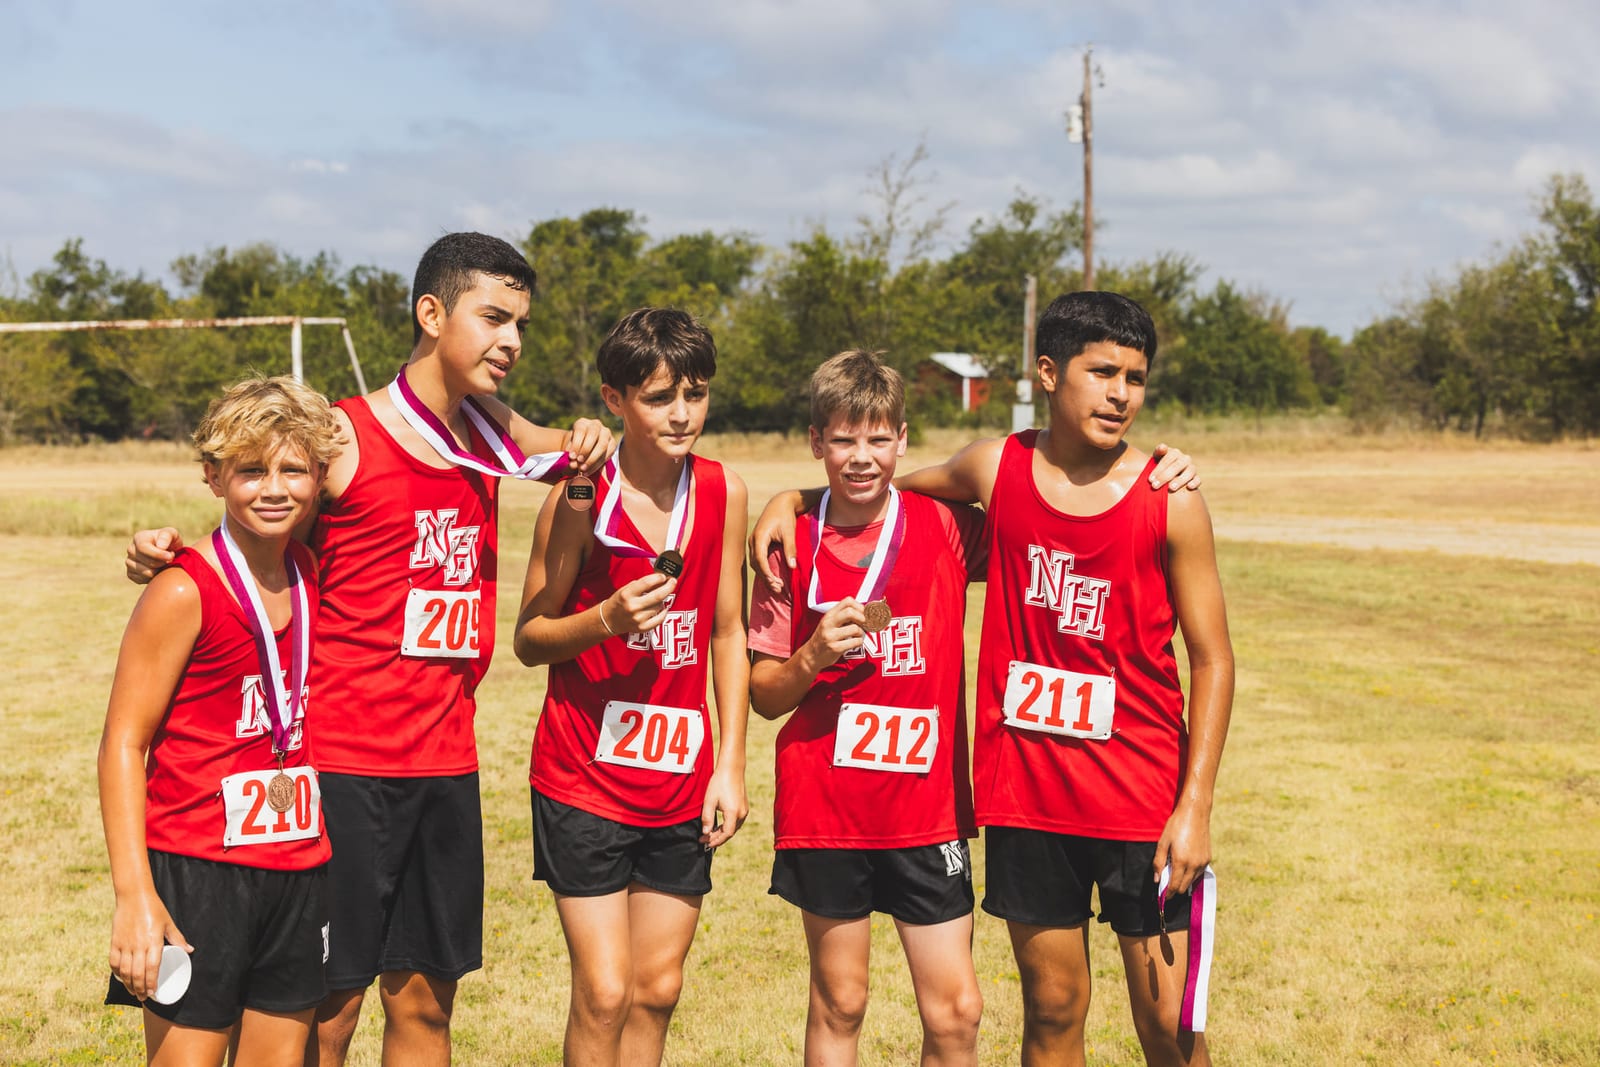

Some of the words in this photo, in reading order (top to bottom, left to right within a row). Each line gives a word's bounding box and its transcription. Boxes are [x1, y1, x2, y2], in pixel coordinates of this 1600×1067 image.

[409, 509, 481, 586] NH
[1025, 544, 1111, 640] NH
[1016, 671, 1094, 732] 211
[613, 709, 689, 765] 204
[851, 711, 931, 765] 212
